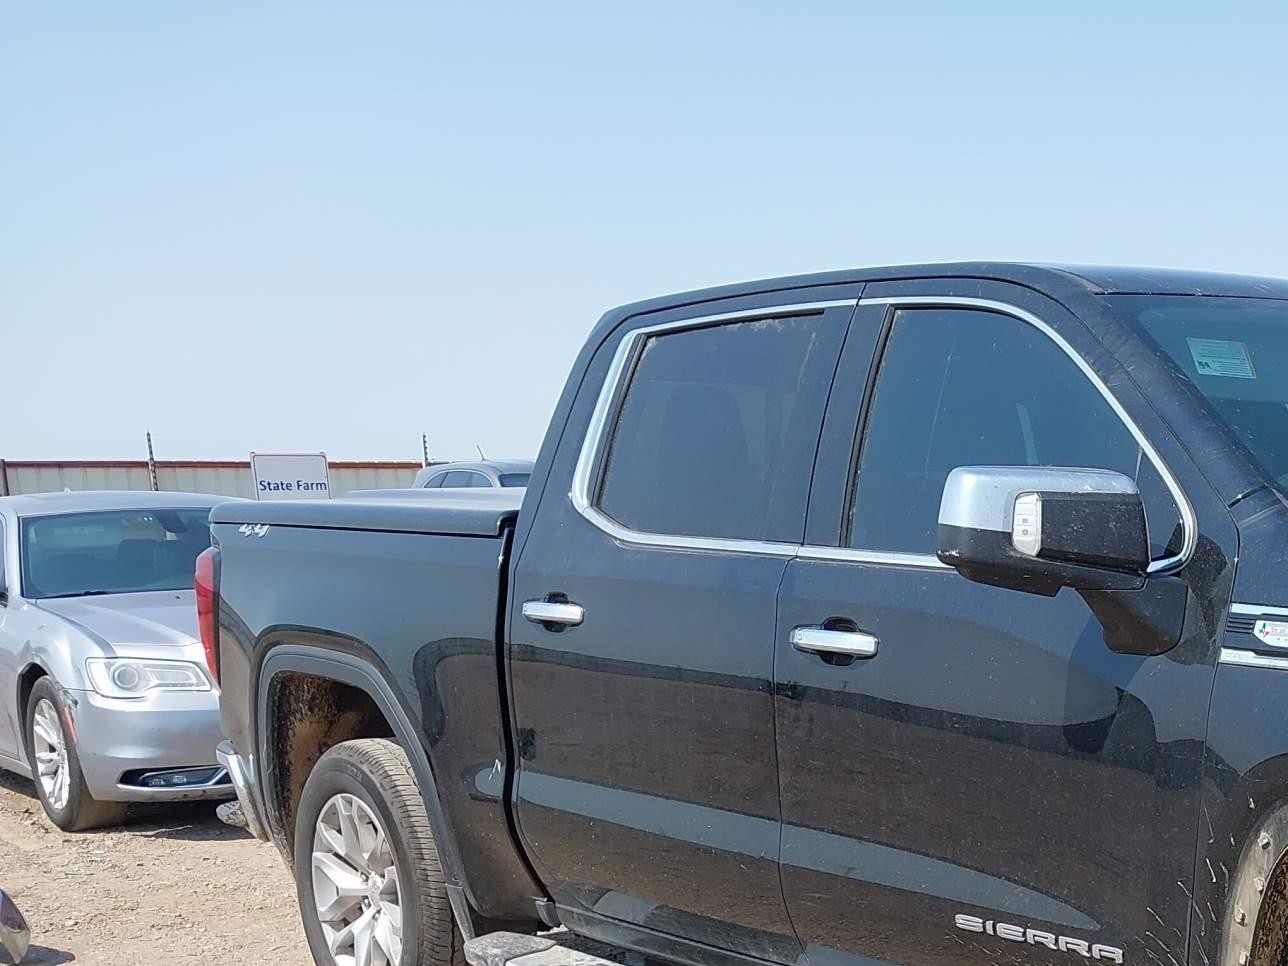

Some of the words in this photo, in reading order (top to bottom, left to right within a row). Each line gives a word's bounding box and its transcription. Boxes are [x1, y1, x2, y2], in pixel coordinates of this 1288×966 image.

[259, 479, 293, 491] State
[296, 479, 327, 491] Farm
[954, 913, 1125, 965] SIERRA
